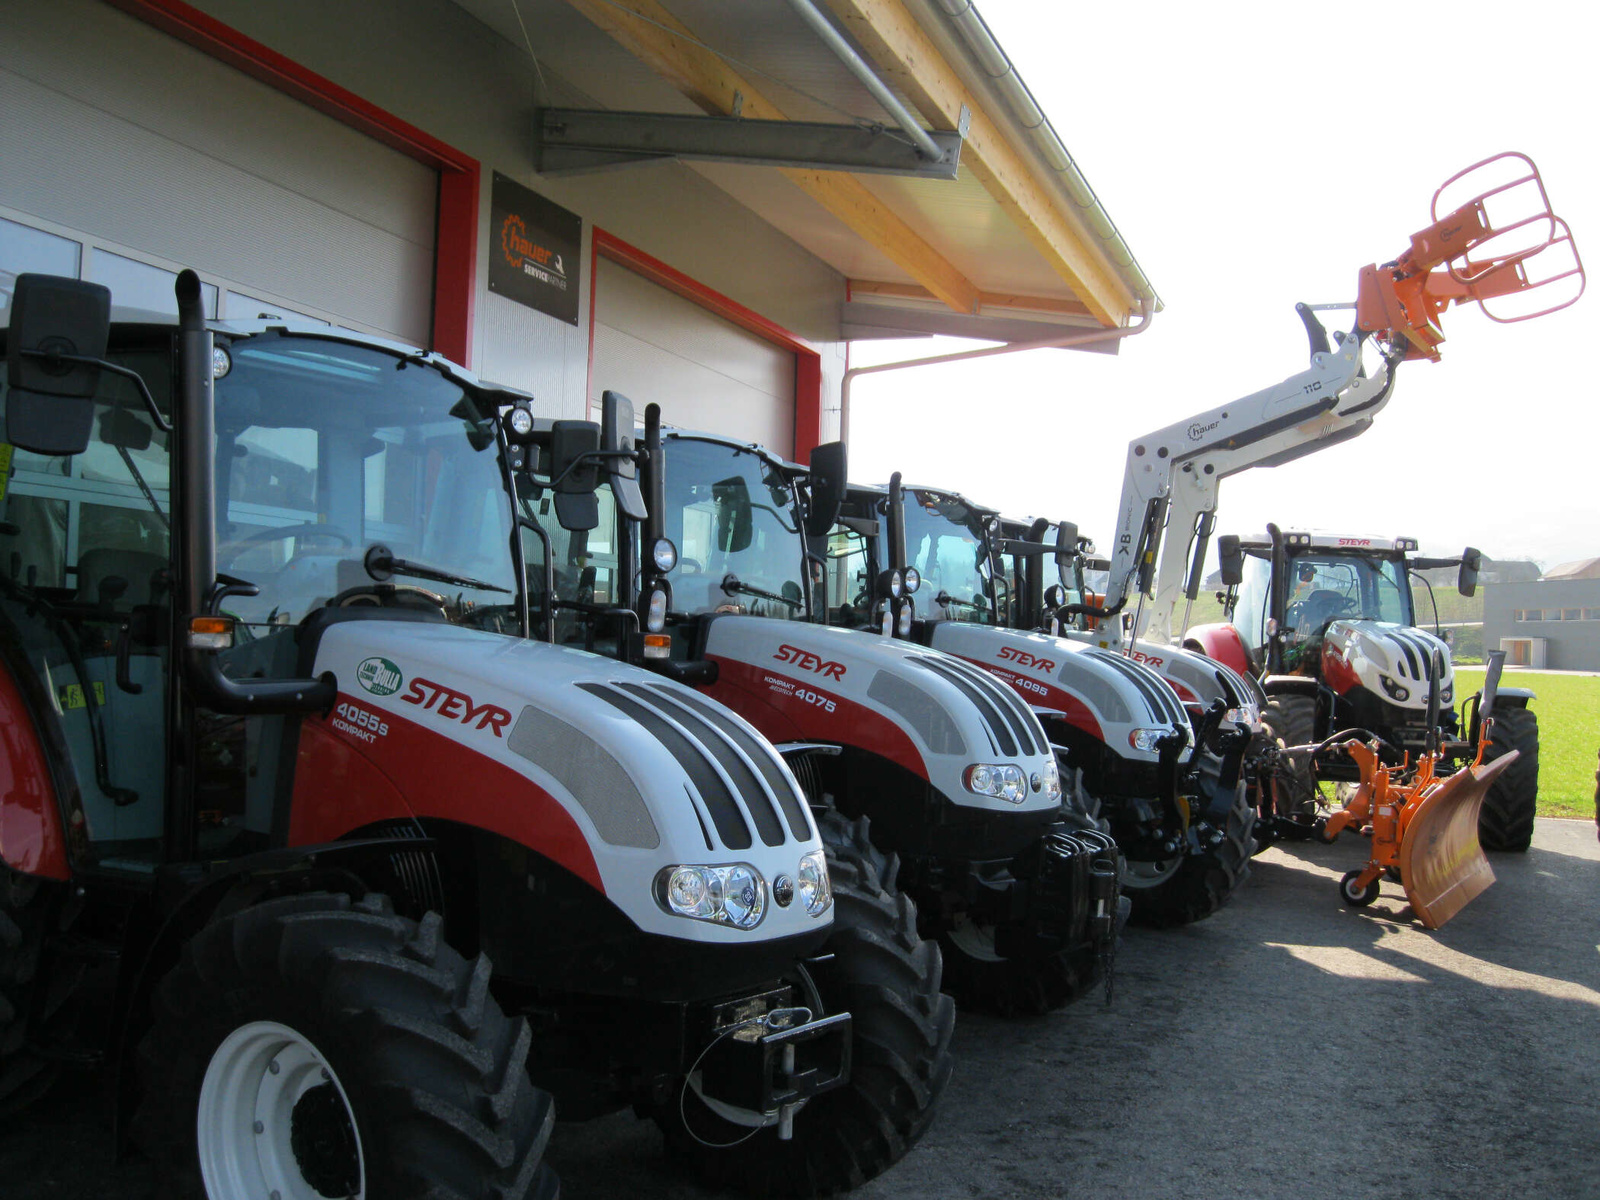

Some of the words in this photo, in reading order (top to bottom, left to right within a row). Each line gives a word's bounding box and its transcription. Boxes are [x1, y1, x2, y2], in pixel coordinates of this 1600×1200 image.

[510, 226, 552, 264] hauer
[1303, 381, 1322, 395] 110
[1192, 420, 1219, 437] hauer
[1338, 538, 1371, 546] STEYR
[773, 644, 847, 682] STEYR
[996, 646, 1056, 674] STEYR
[764, 676, 795, 690] KOMPAKT
[1015, 678, 1049, 696] 4095
[401, 677, 512, 738] STEYR
[795, 689, 837, 713] 4075
[332, 717, 377, 744] KOMPAKT
